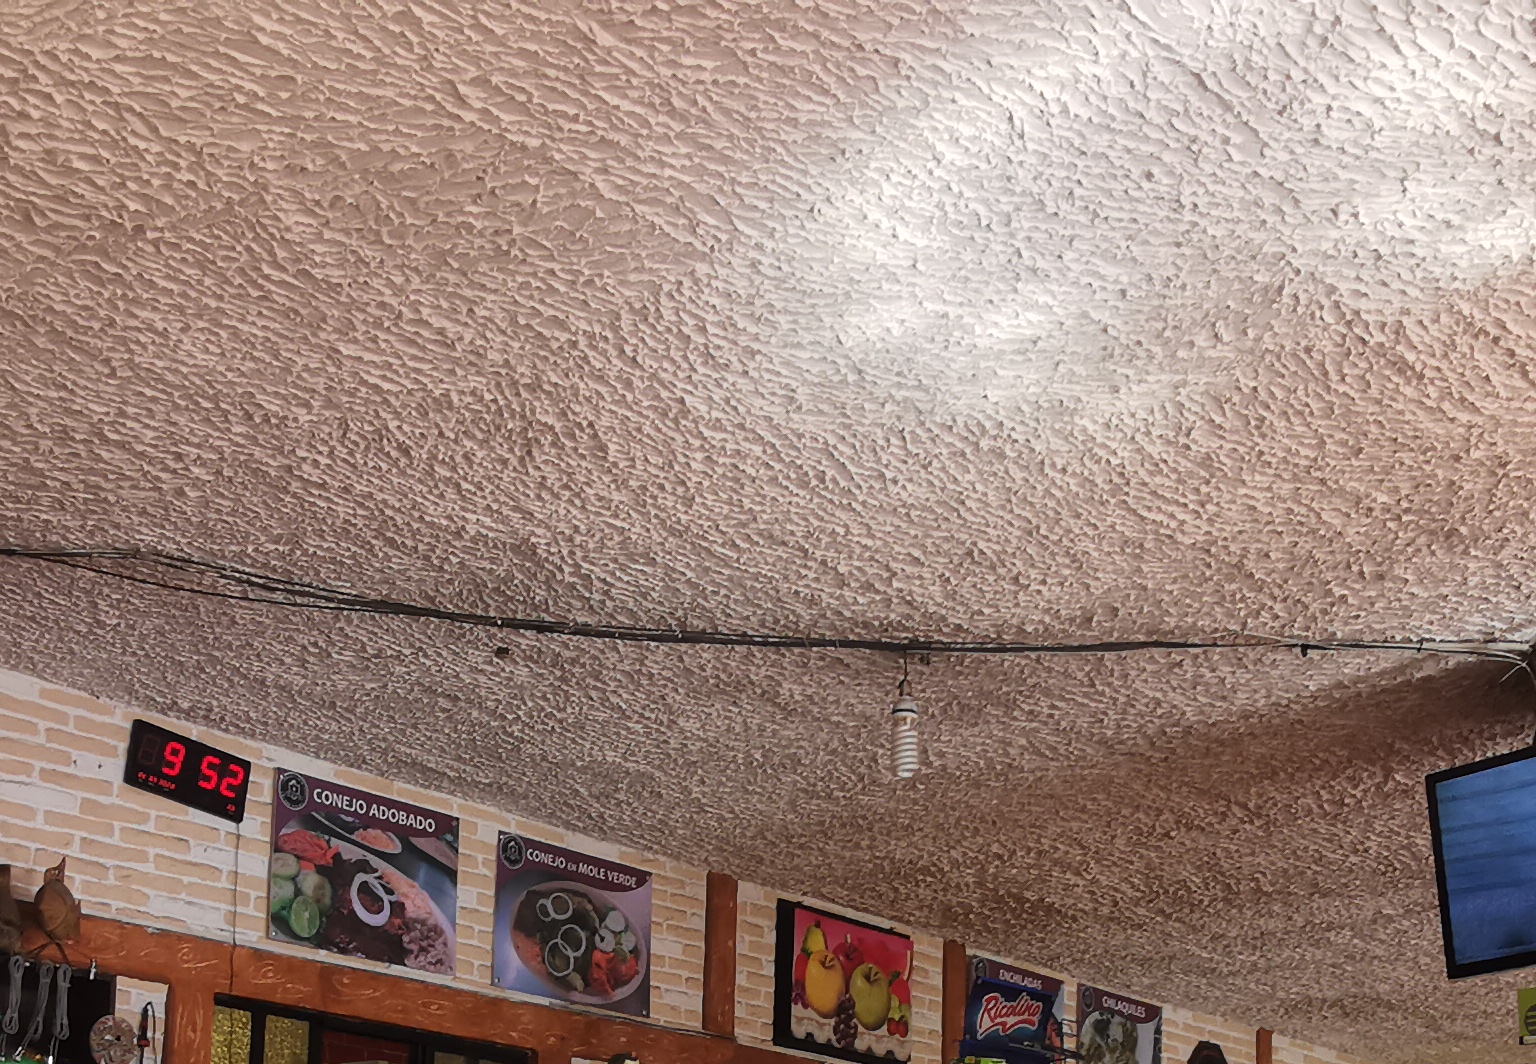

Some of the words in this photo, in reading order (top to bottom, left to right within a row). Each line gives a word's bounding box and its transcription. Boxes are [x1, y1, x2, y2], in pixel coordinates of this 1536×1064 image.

[161, 741, 186, 776] 9
[197, 755, 245, 798] 52
[313, 788, 367, 814] CONEJO
[368, 803, 436, 833] ADOBADO
[526, 848, 566, 869] CONEJO
[577, 862, 606, 879] MOLE
[606, 870, 637, 888] VERDE
[977, 992, 1043, 1035] Ricolino
[1101, 995, 1147, 1018] CHILAQUILES
